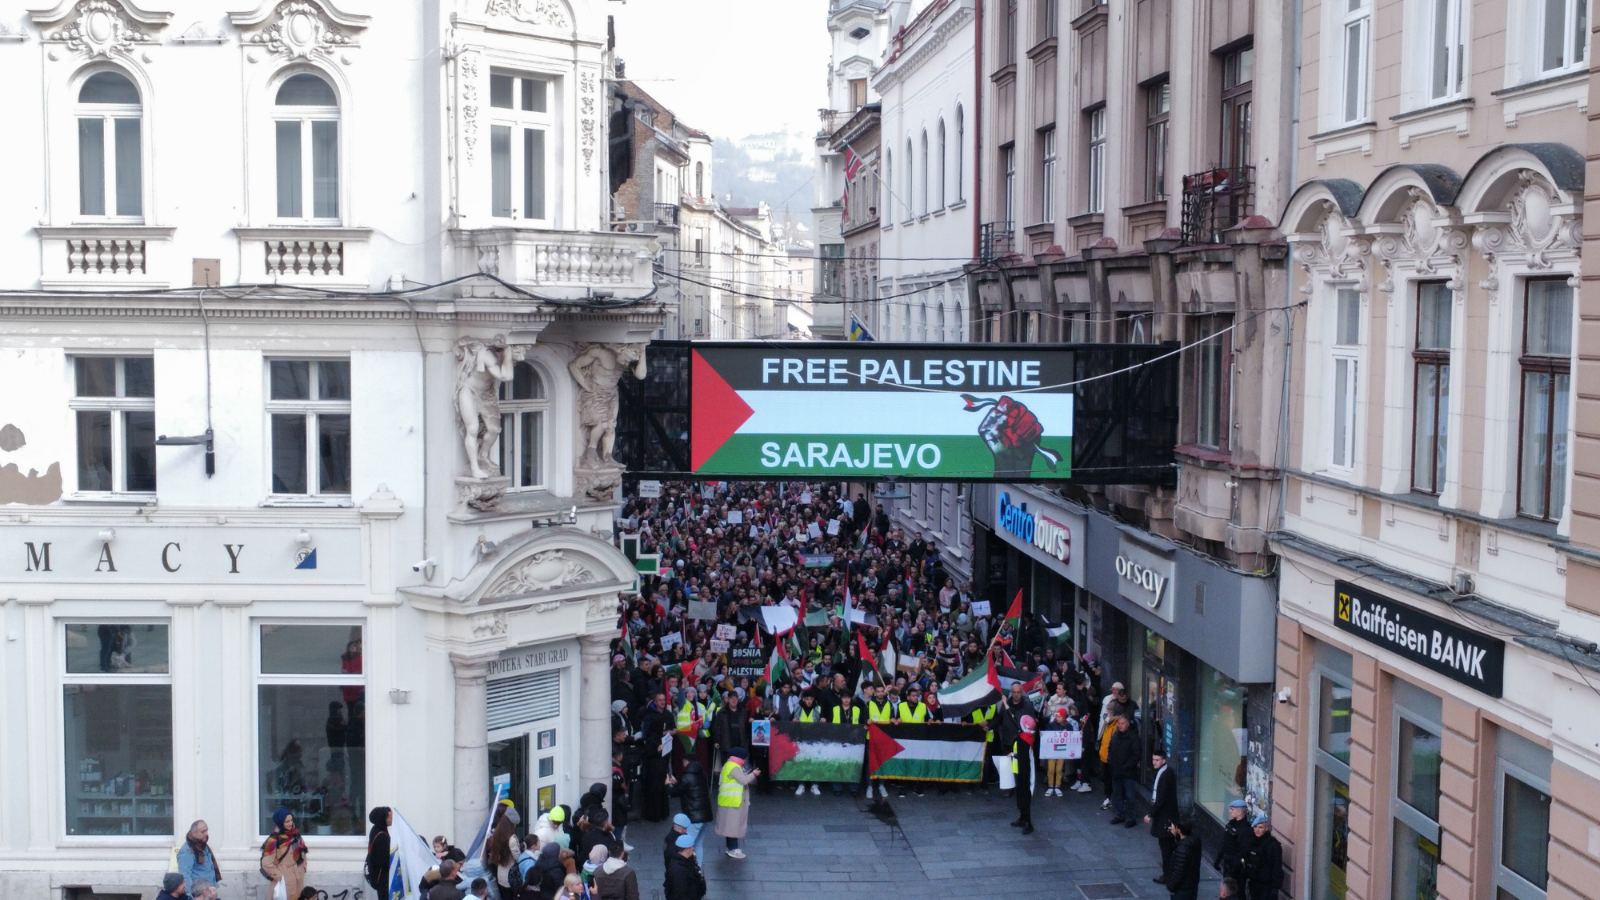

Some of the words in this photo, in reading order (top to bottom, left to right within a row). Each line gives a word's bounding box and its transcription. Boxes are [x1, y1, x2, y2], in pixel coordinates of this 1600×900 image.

[762, 358, 848, 385] FREE
[860, 359, 1041, 386] PALESTINE
[760, 442, 942, 469] SARAJEVO
[1115, 554, 1168, 608] orsay
[1352, 597, 1427, 655] Raiffeisen
[1430, 630, 1487, 680] BANK
[525, 651, 547, 668] STARI
[548, 647, 569, 664] GRAD
[733, 648, 761, 657] BOSNIA
[728, 667, 764, 676] PALESTINE
